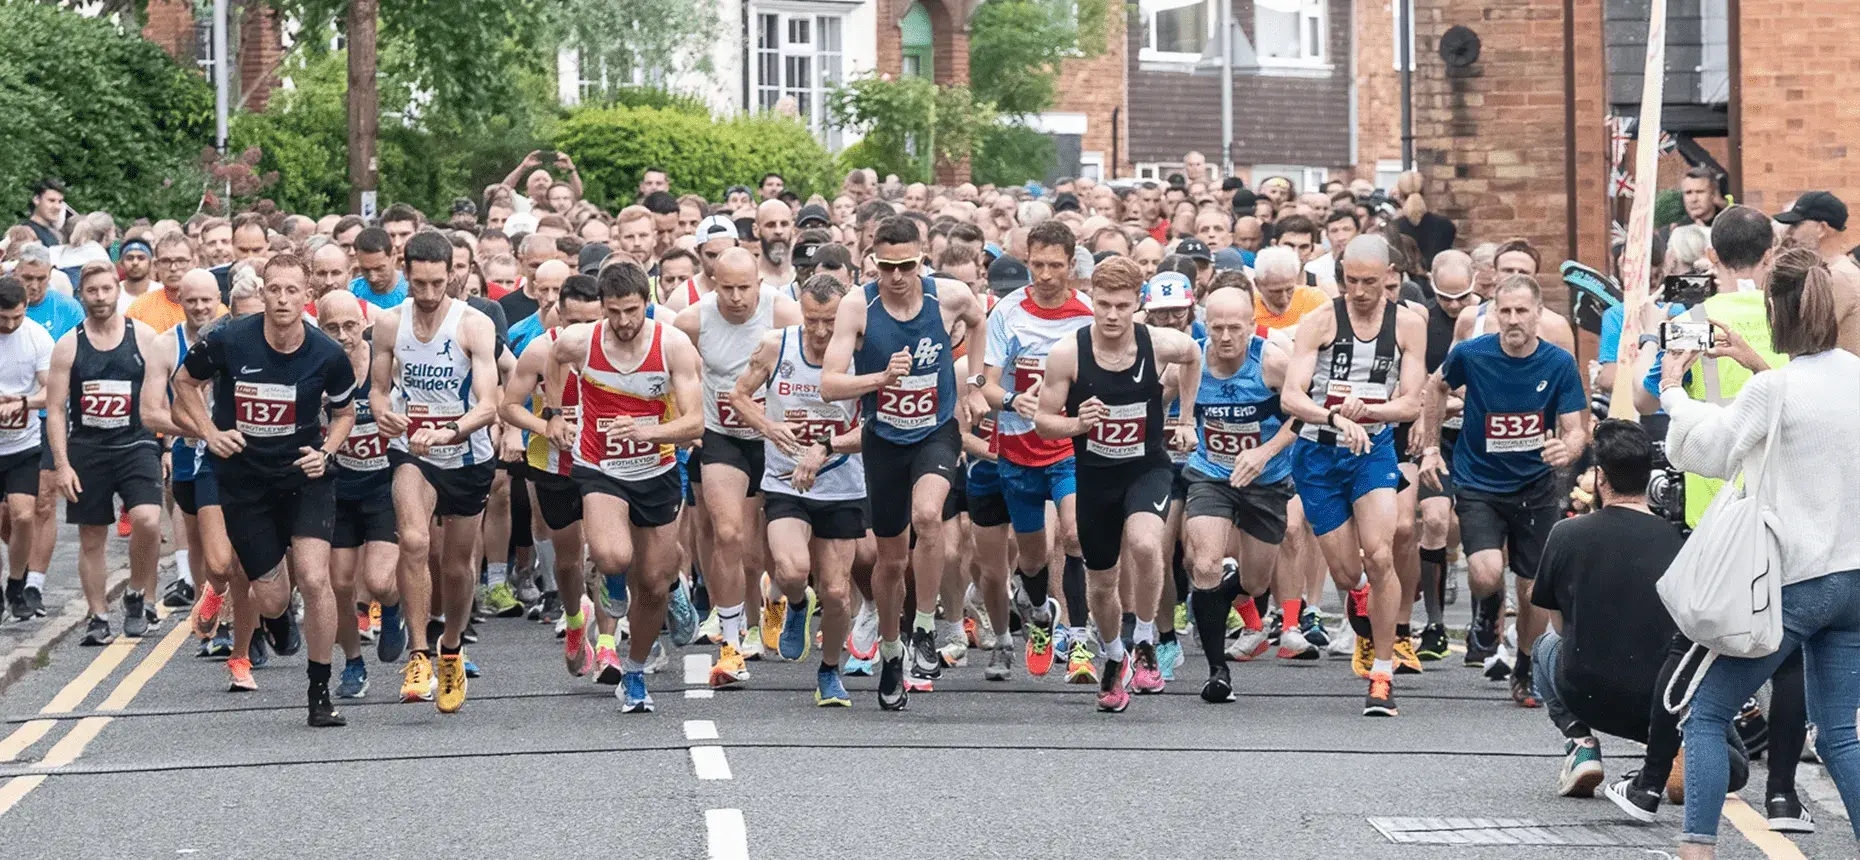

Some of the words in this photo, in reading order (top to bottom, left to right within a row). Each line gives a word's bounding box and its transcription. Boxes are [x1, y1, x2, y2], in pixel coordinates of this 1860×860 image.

[404, 363, 454, 377] Stilton
[85, 396, 126, 415] 272
[241, 401, 288, 423] 137
[882, 392, 934, 415] 266
[809, 424, 836, 443] 51
[1093, 422, 1139, 444] 122
[1490, 414, 1540, 436] 532
[1208, 434, 1258, 453] 630
